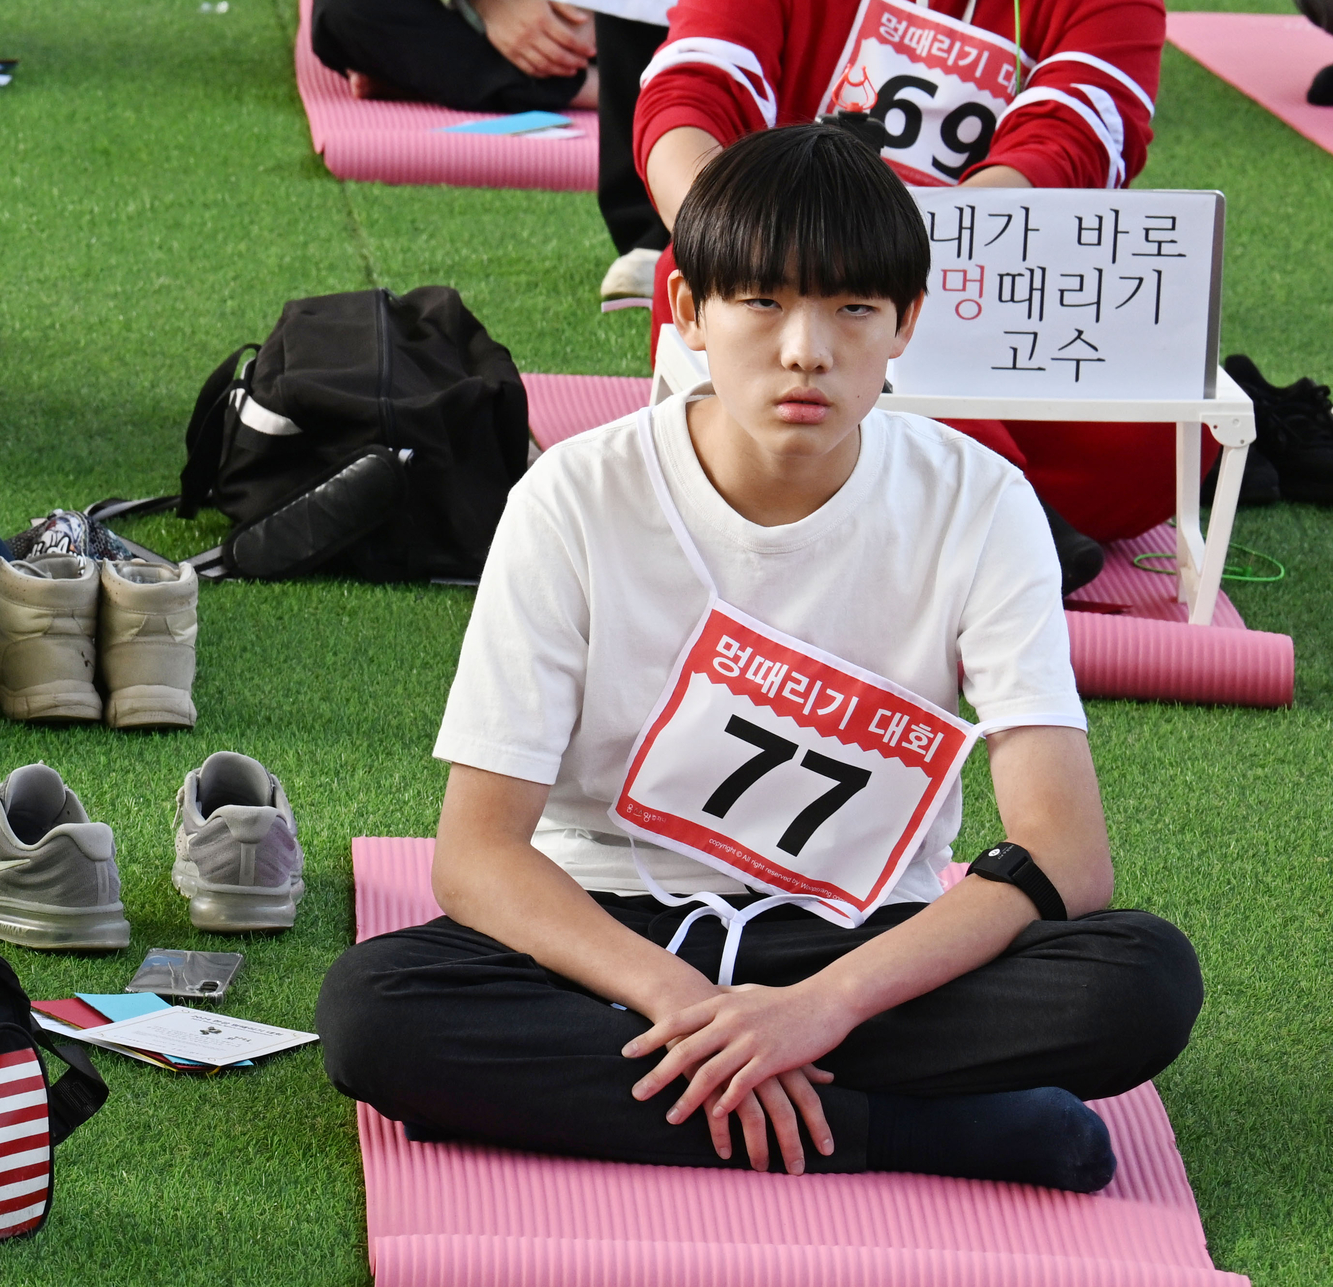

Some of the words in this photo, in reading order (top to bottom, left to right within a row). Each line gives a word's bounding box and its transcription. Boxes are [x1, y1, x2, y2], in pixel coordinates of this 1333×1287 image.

[879, 11, 990, 78] 멍때리기
[869, 74, 997, 181] 69
[927, 204, 1040, 262] 내가
[1074, 208, 1187, 264] 바로
[941, 263, 1163, 325] 멍때리기
[990, 328, 1106, 383] 고수
[712, 634, 860, 730] 멍때리기
[867, 708, 945, 763] 대회
[701, 713, 873, 858] 77
[708, 837, 736, 854] copyright
[742, 854, 751, 863] All
[750, 859, 765, 871] right
[765, 866, 791, 883] reserved
[791, 875, 801, 886] by
